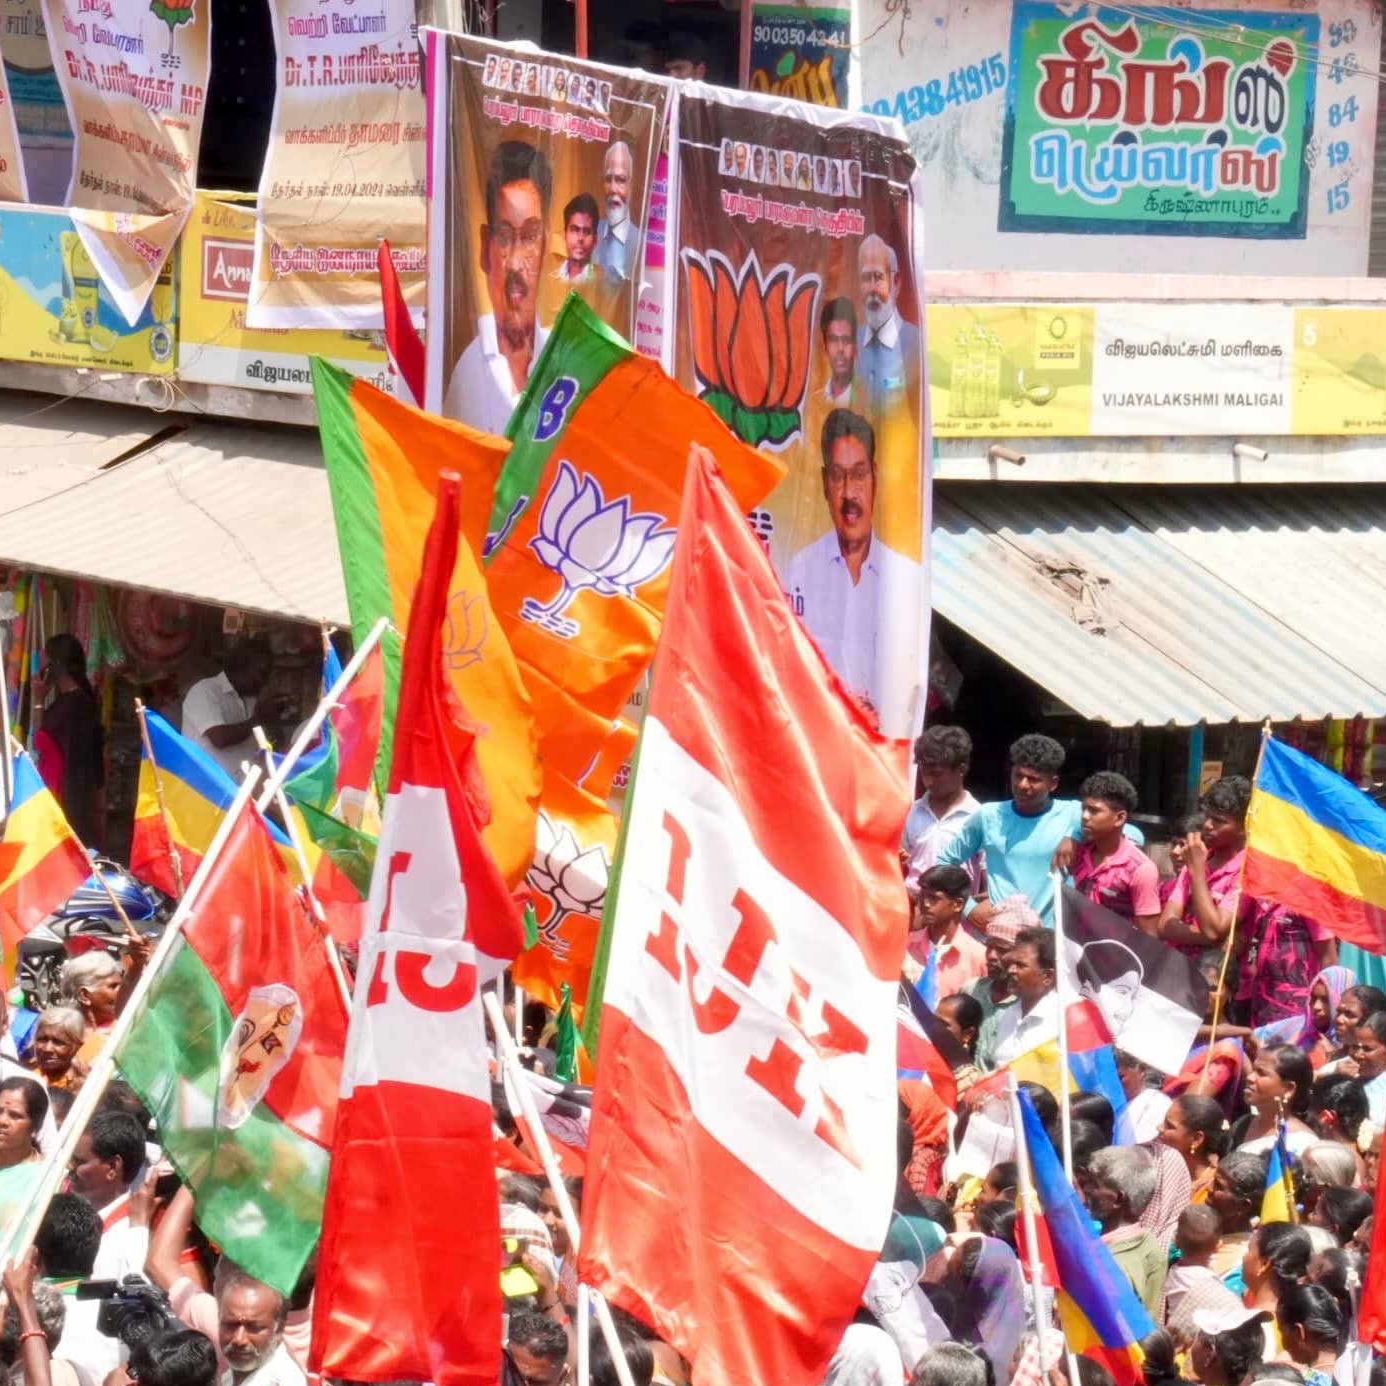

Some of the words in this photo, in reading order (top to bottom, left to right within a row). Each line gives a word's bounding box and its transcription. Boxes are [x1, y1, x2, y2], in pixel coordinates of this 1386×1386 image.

[288, 13, 328, 38] வெற்றி
[332, 10, 387, 35] வேட்பாளர்
[1328, 95, 1359, 128] 84
[348, 121, 401, 150] தாமரை
[1326, 140, 1350, 169] 19
[331, 181, 383, 199] 19.04.2024
[1325, 180, 1351, 214] 15
[1105, 338, 1216, 360] விஜயலெட்சுமி
[1221, 340, 1284, 357] மளிகை
[1102, 393, 1220, 407] VIJAYALAKSHMI
[1224, 393, 1284, 407] MALIGAI
